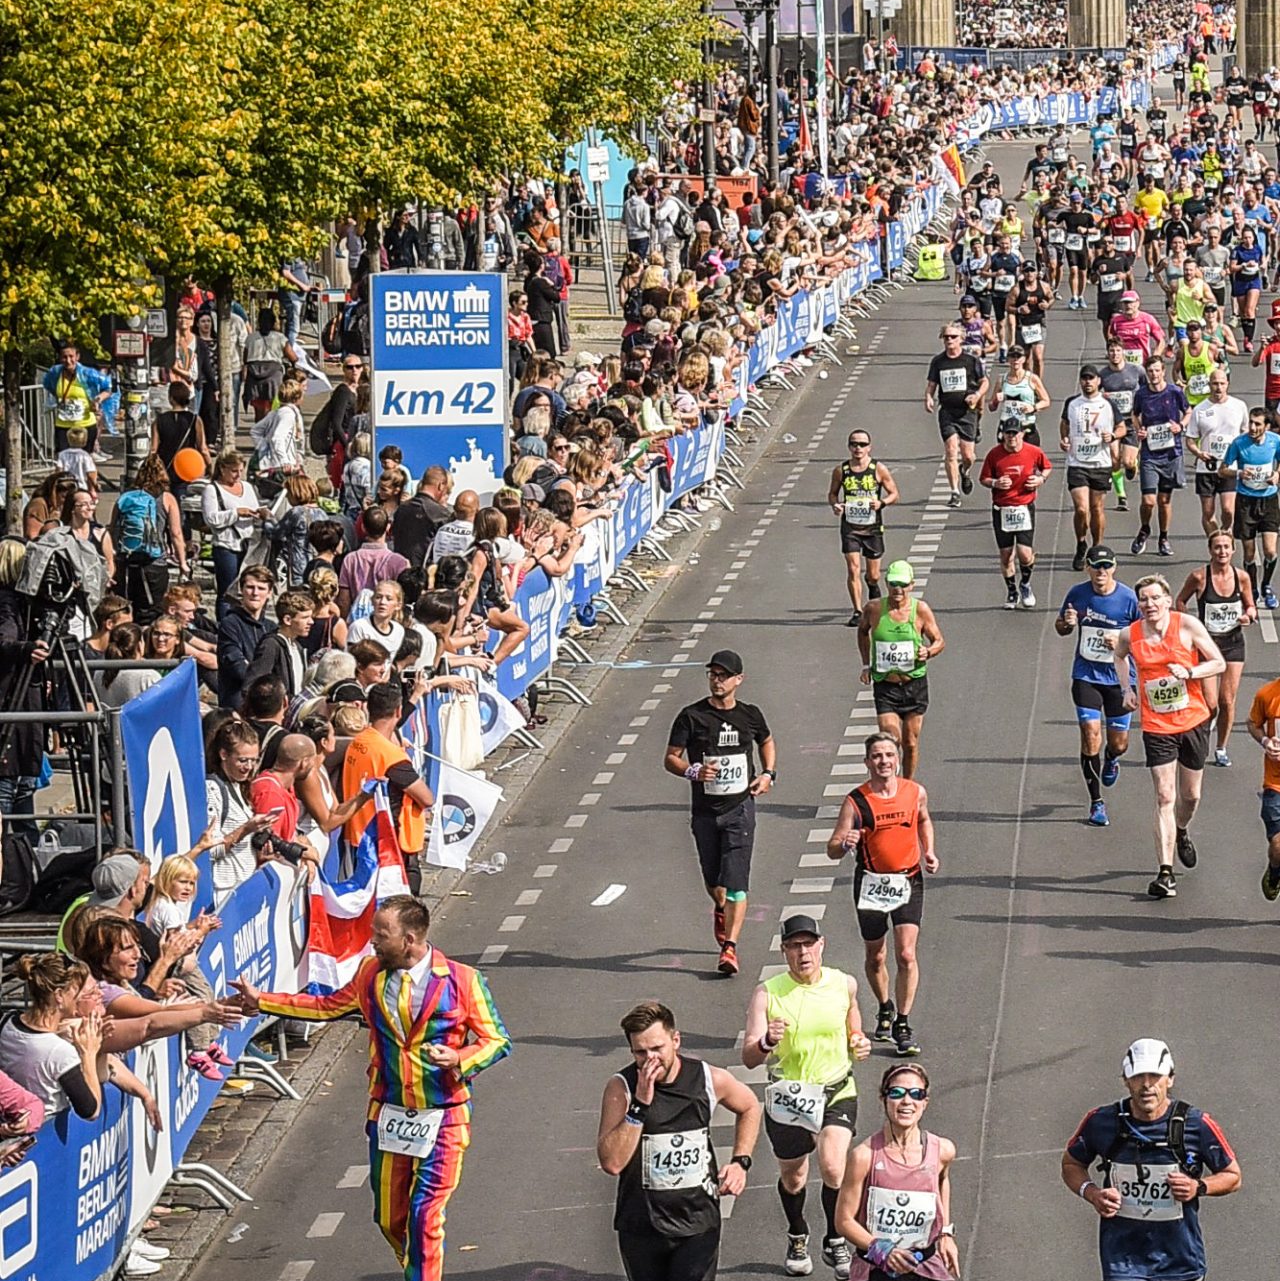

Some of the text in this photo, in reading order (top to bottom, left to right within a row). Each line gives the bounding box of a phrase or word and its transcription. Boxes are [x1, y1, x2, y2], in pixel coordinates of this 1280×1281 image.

[384, 291, 449, 311] BMW
[385, 313, 450, 329] BERLIN
[385, 330, 490, 346] MARATHON
[382, 381, 497, 416] km 42
[882, 651, 909, 663] 14623
[1153, 687, 1179, 701] 4529
[868, 883, 904, 898] 24904
[774, 1092, 816, 1114] 25422
[386, 1118, 430, 1138] 61700
[79, 1125, 119, 1190] BMW
[653, 1147, 700, 1168] 14353
[78, 1172, 118, 1227] BERLIN
[1121, 1181, 1170, 1200] 35762
[877, 1207, 926, 1227] 15306
